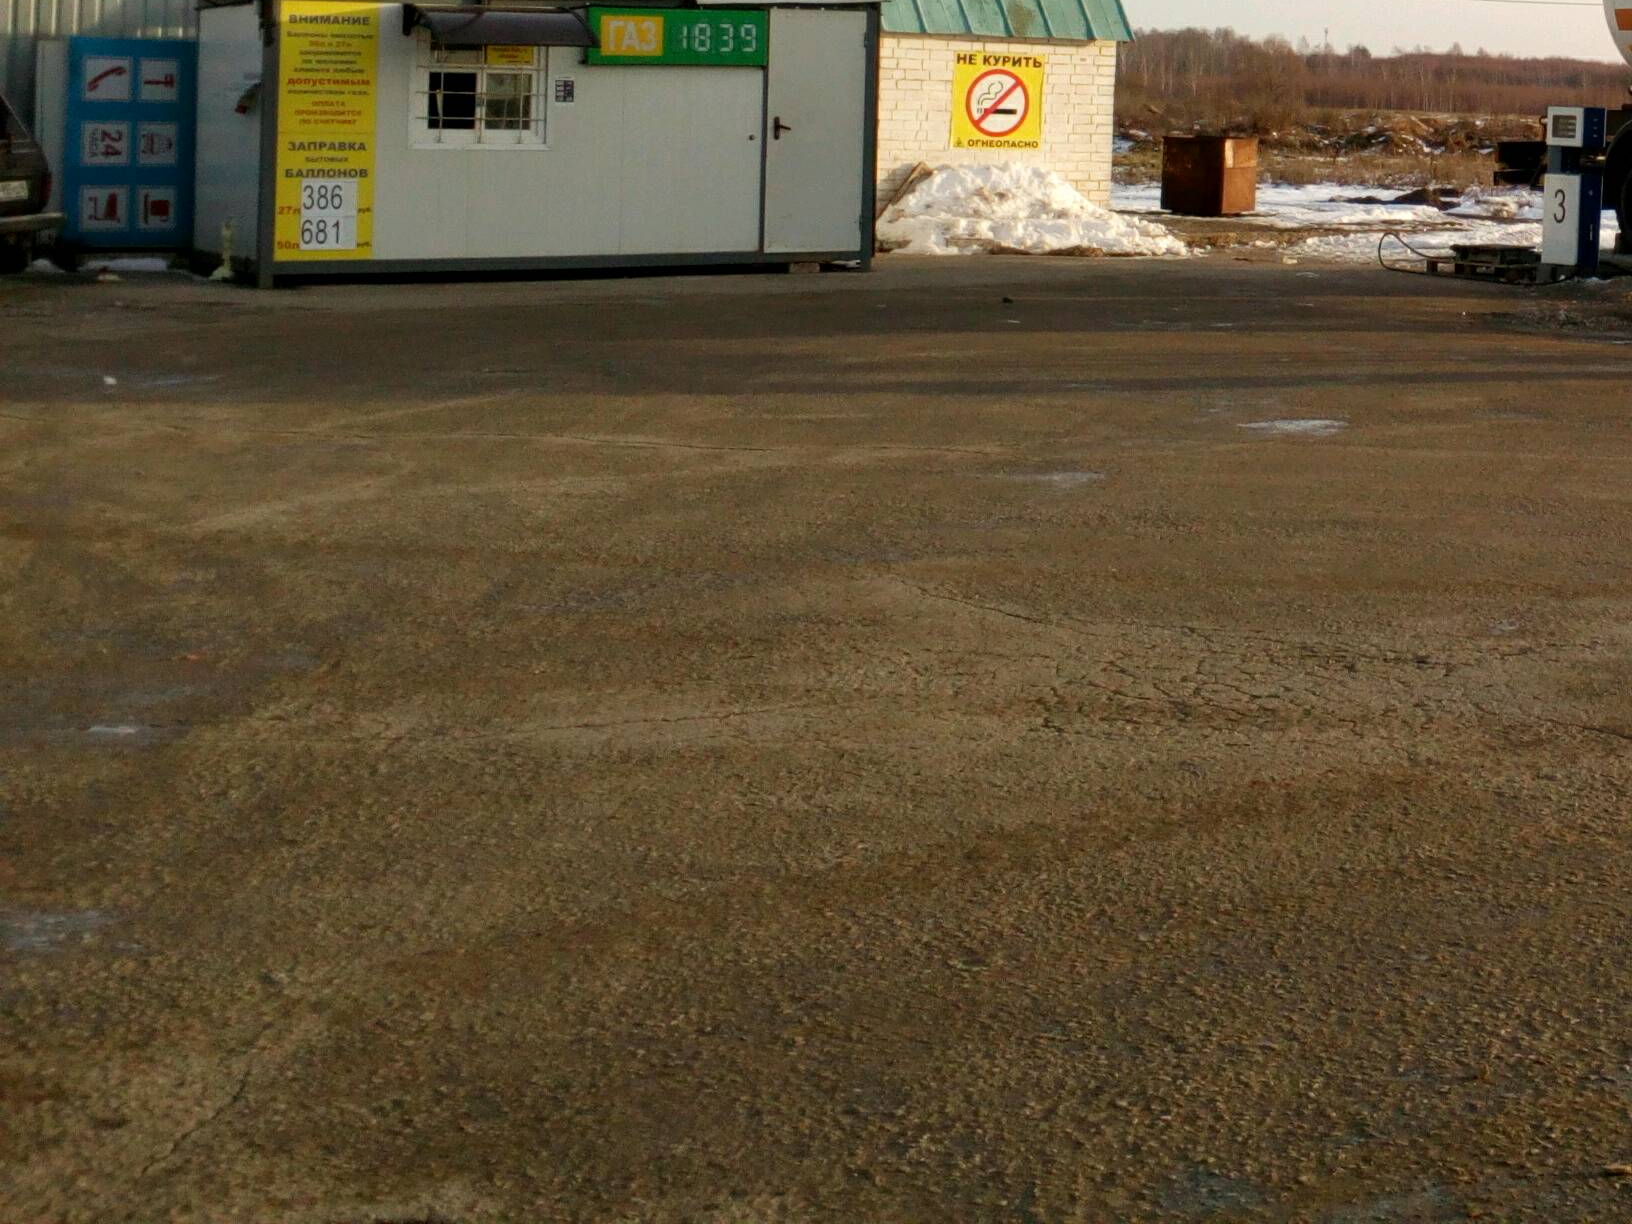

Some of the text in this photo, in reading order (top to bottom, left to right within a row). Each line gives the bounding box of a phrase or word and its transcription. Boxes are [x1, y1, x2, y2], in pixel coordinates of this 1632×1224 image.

[288, 14, 370, 26] ВНИМАНИЕ
[608, 20, 657, 52] ГАЗ
[956, 53, 1043, 69] НЕ КУРИТЬ
[288, 78, 370, 88] допустимым
[100, 129, 123, 159] 24
[288, 141, 368, 152] ЗАПРАВКА
[967, 138, 1039, 149] ОГНЕОПАСНО
[285, 168, 369, 179] БАЛЛОНОВ
[302, 184, 343, 211] 386
[1553, 188, 1567, 224] 3
[301, 219, 340, 245] 681
